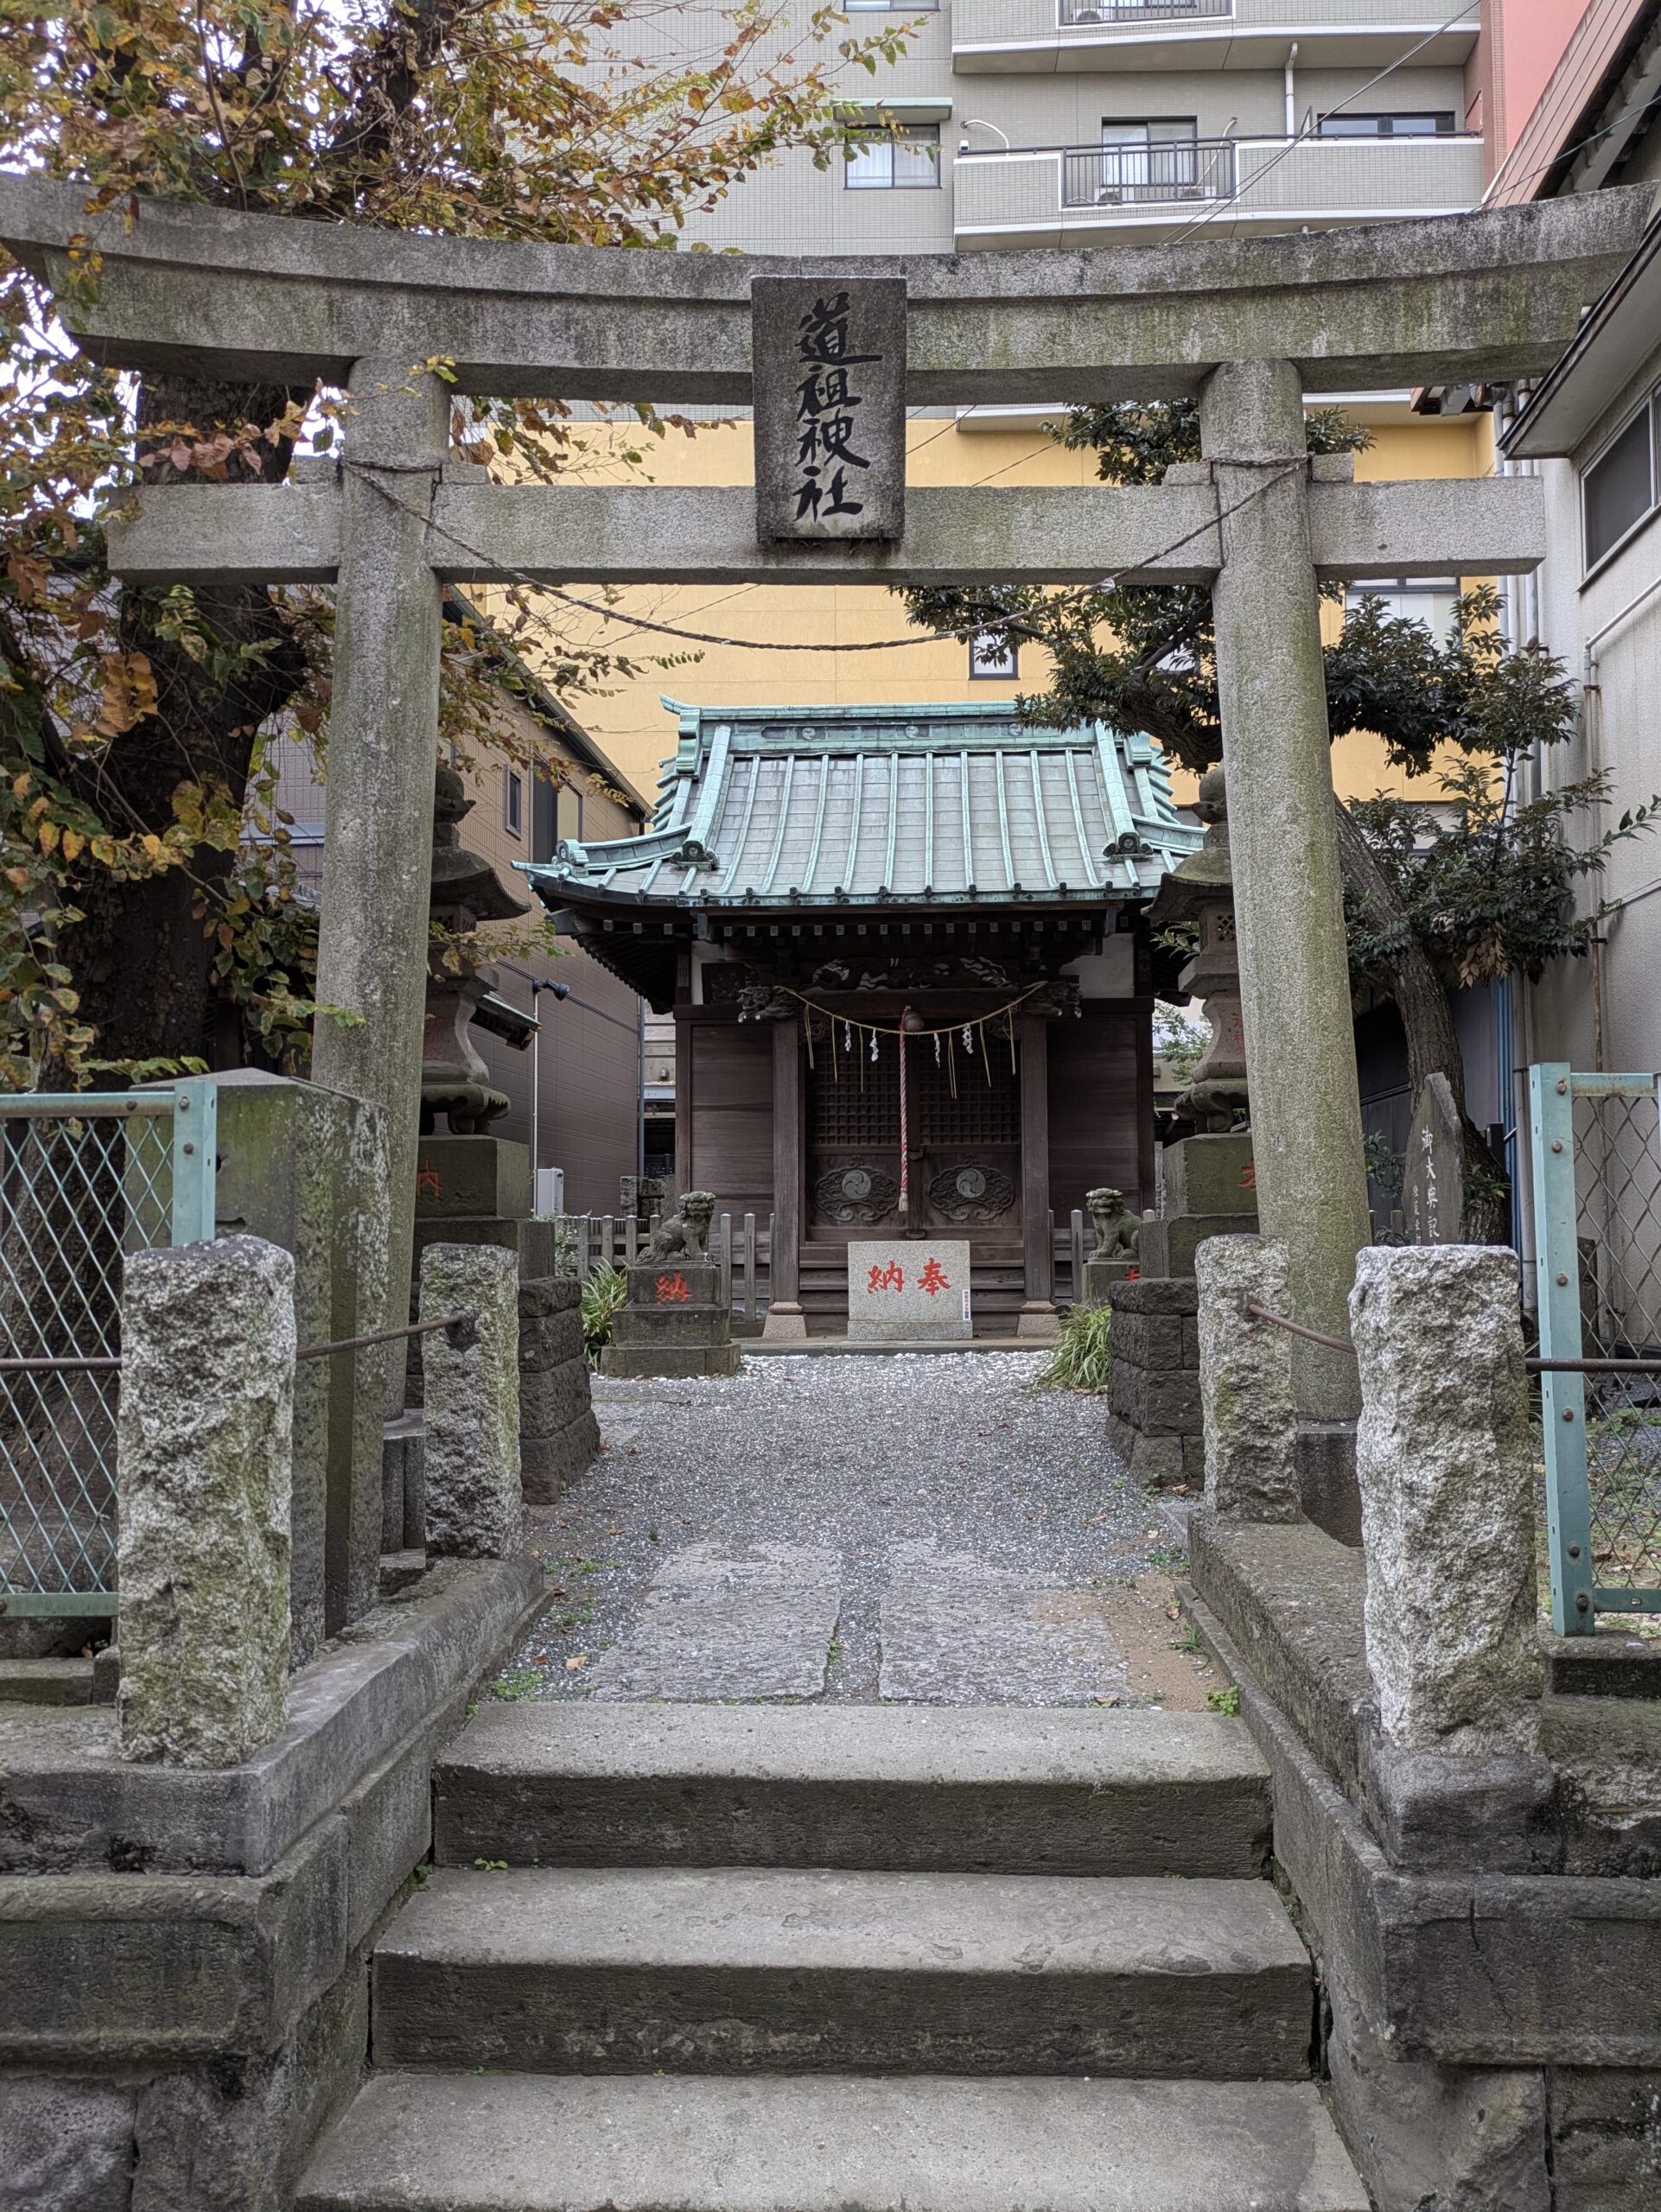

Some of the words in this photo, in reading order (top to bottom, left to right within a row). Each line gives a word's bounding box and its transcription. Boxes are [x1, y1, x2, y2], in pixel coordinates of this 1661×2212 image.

[792, 291, 883, 523] 道祖神社
[1421, 1123, 1441, 1245] 御大典記
